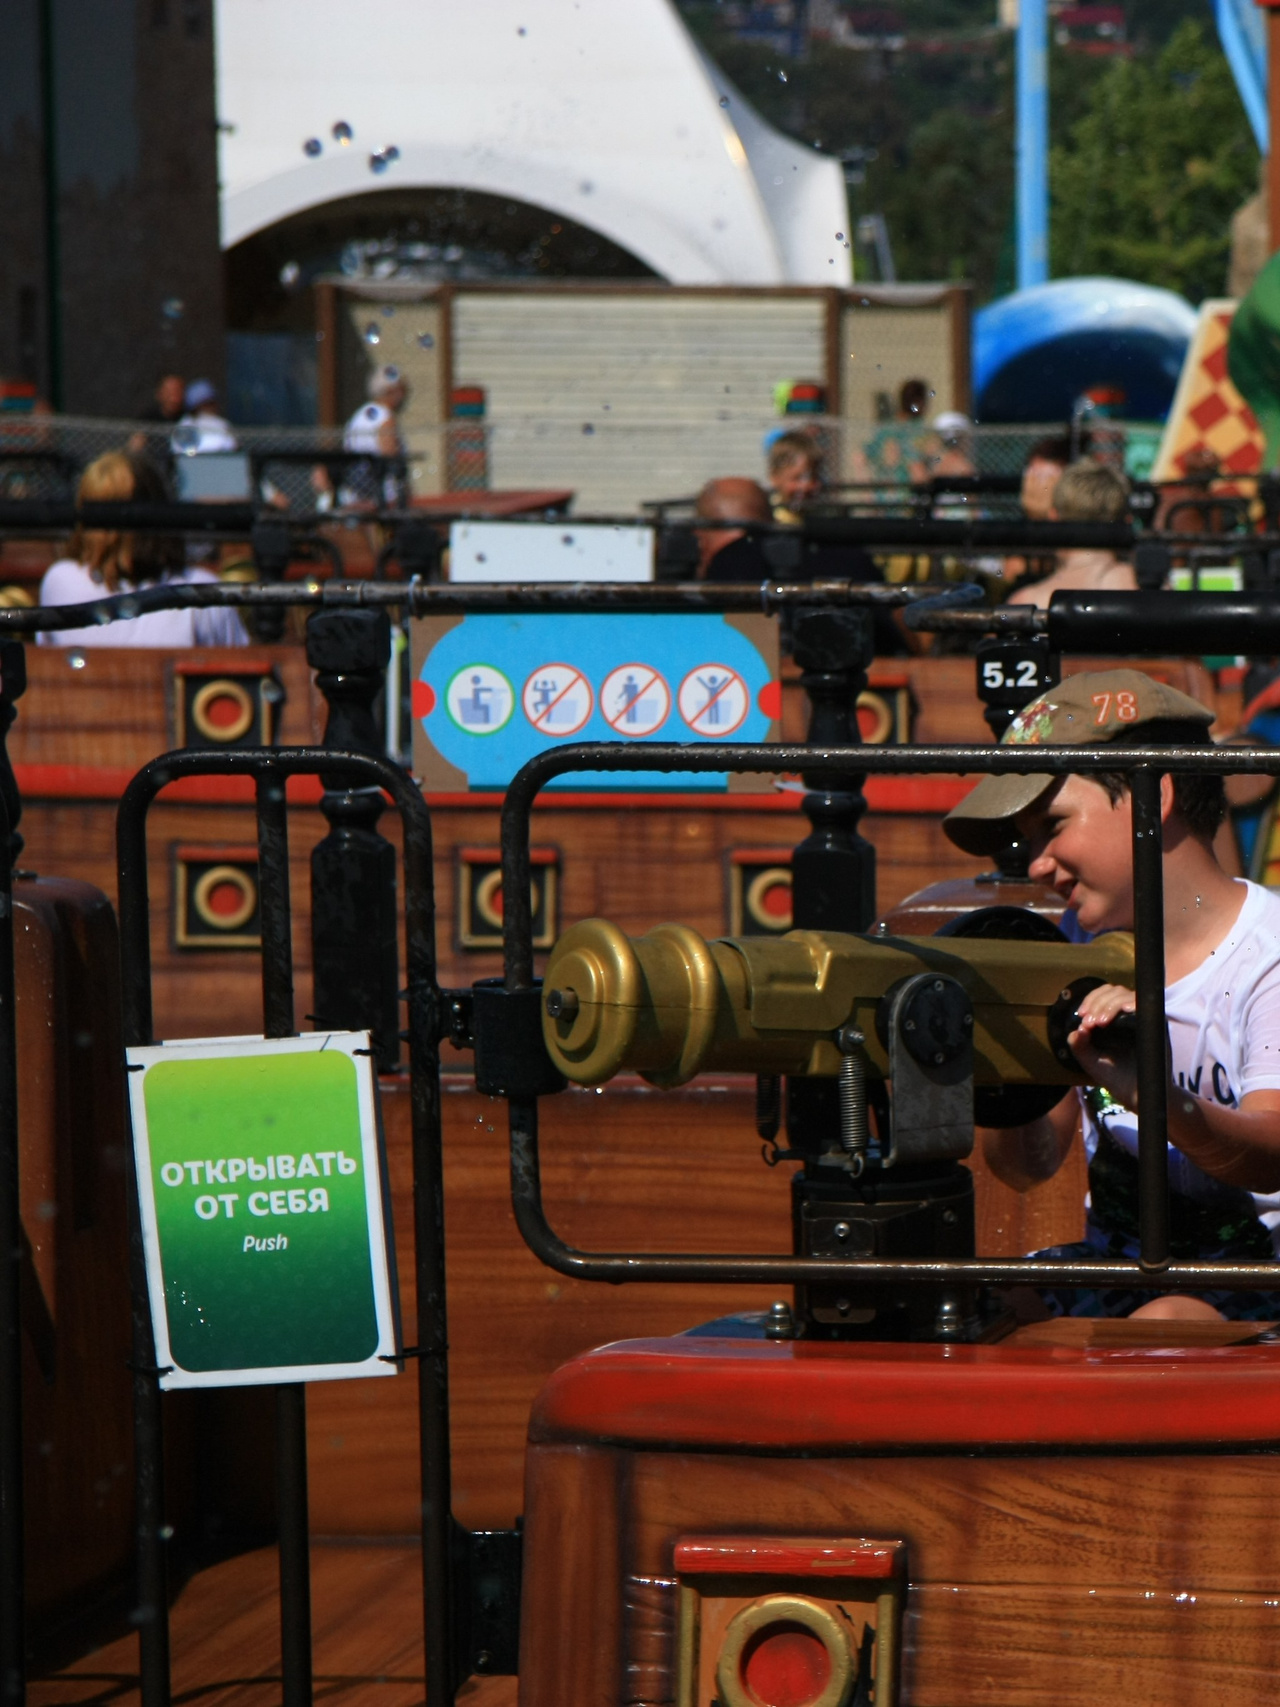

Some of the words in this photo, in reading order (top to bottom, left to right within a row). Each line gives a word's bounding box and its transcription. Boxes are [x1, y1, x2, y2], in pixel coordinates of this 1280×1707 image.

[982, 660, 1038, 688] 5.2
[1091, 690, 1139, 725] 78
[160, 1151, 357, 1187] ОТКРЫВАТЬ
[194, 1194, 239, 1220] ОТ
[248, 1188, 329, 1217] СЕБЯ
[243, 1233, 288, 1252] Push
